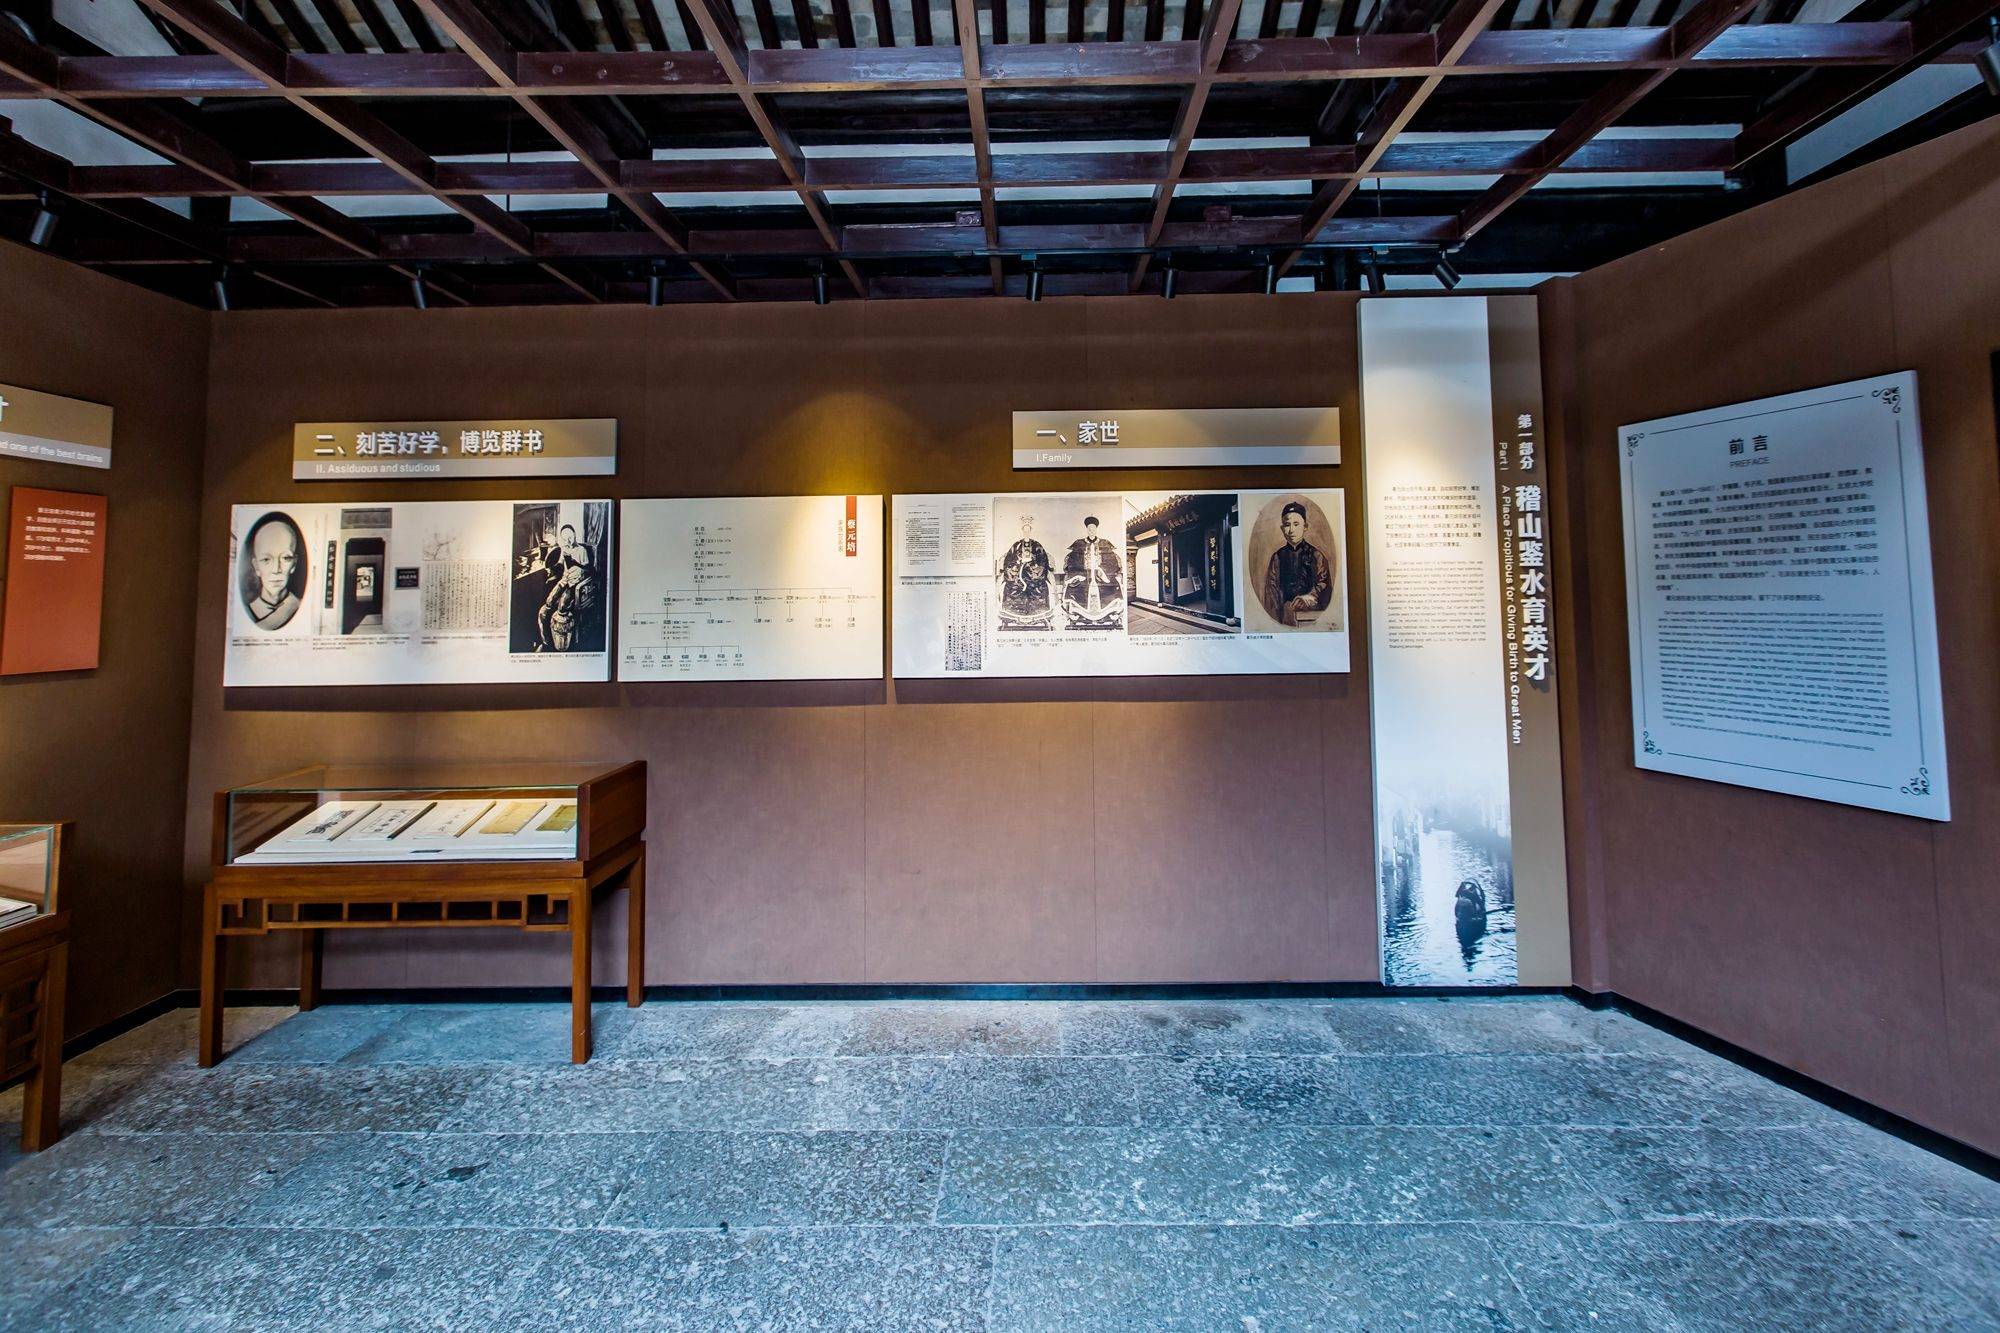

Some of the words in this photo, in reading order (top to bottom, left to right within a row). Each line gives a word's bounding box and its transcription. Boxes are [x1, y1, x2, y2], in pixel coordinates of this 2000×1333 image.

[1036, 421, 1120, 443] 一、家世
[1518, 414, 1534, 470] 第一部分
[9, 443, 28, 452] one
[29, 445, 40, 453] of
[40, 447, 55, 456] the
[56, 449, 76, 460] best
[76, 453, 103, 463] brains
[1499, 442, 1509, 465] Part
[1728, 435, 1768, 455] 前言
[327, 464, 378, 473] Assiduous
[380, 463, 398, 473] and
[399, 462, 440, 472] studious
[1729, 457, 1771, 468] PREFACE
[1502, 485, 1511, 494] A
[1502, 496, 1511, 526] Place
[1504, 529, 1515, 585] Propitious
[1506, 586, 1516, 602] for
[1507, 604, 1517, 640] Giving
[1508, 642, 1519, 669] Birth
[1510, 670, 1519, 682] to
[1510, 684, 1521, 717] Great
[1512, 719, 1522, 744] Men
